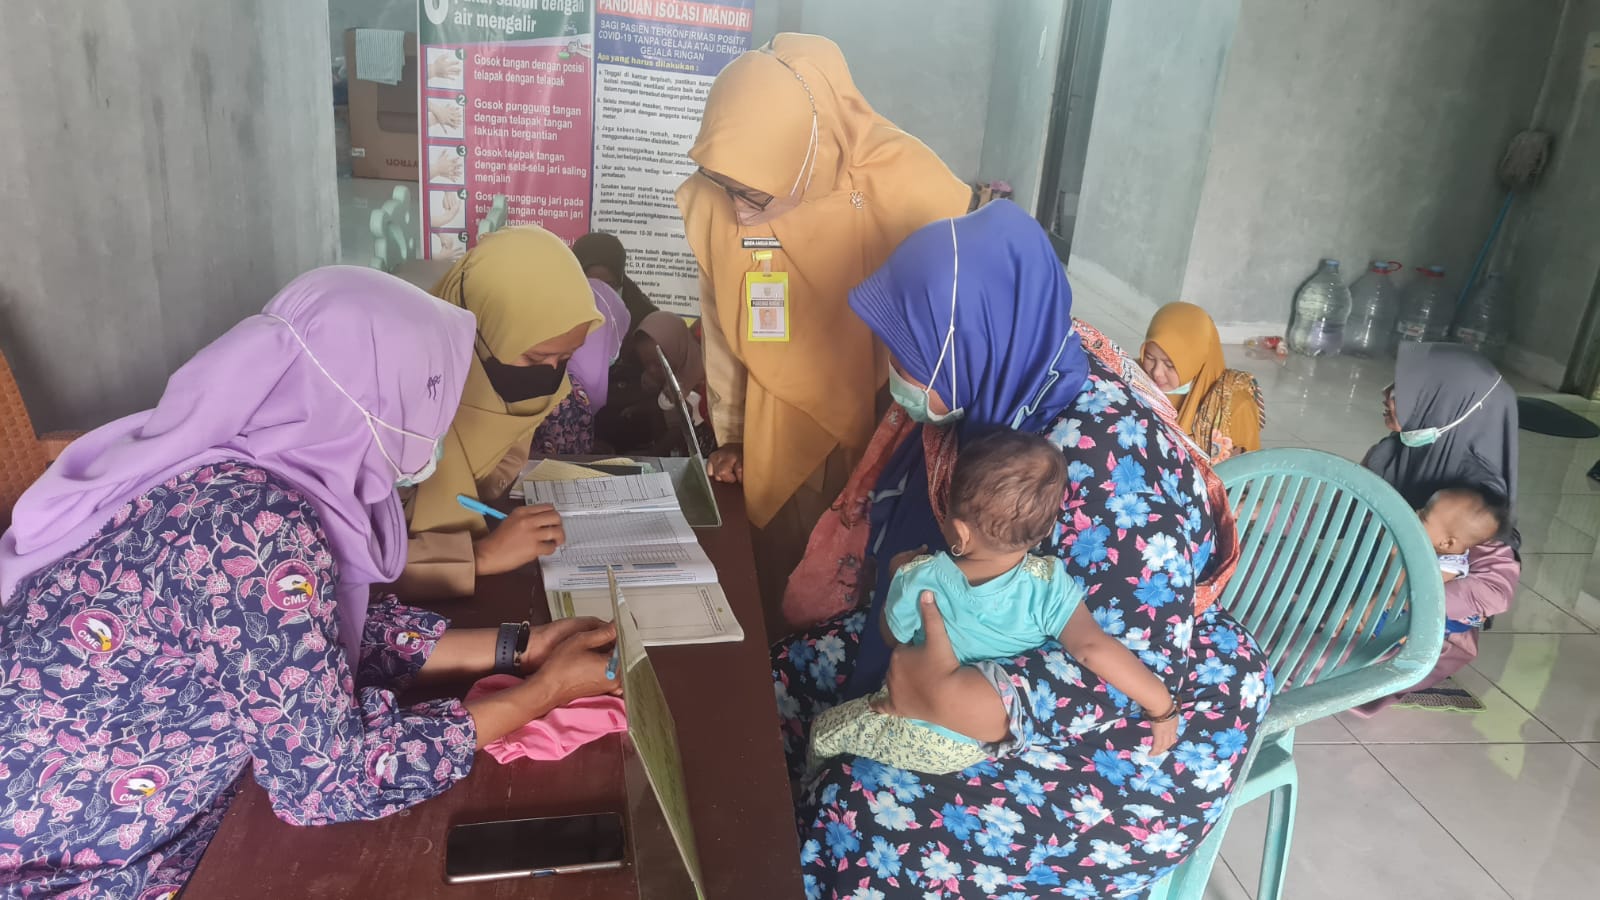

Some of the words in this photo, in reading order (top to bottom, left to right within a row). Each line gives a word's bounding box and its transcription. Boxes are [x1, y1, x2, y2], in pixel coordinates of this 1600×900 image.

[454, 9, 473, 26] air
[476, 13, 536, 34] mengalir
[600, 0, 651, 16] PANDUAN
[655, 1, 699, 22] ISOLASI
[703, 7, 750, 27] MANDIRI
[600, 20, 619, 30] BAGI
[620, 22, 650, 34] PASIEN
[651, 26, 717, 42] TERKONFIRMASI
[718, 34, 746, 45] POSITIF
[598, 31, 632, 42] COVID-19
[633, 34, 660, 47] TANPA
[662, 38, 693, 50] GELAJA
[694, 41, 715, 53] ATAU
[716, 44, 747, 55] DENGAN
[640, 46, 672, 58] GEJALA
[674, 49, 704, 61] RINGAN
[474, 54, 501, 67] Gosok
[503, 56, 529, 71] tangan
[531, 58, 562, 73] dengan
[563, 62, 585, 74] posisi
[610, 55, 630, 65] yang
[631, 57, 653, 67] harus
[655, 59, 695, 71] dilakukan
[474, 70, 503, 83] telapak
[505, 72, 535, 86] dengan
[536, 74, 564, 87] telapak
[458, 95, 465, 105] 2
[474, 98, 503, 110] Gosok
[505, 101, 550, 115] punggung
[552, 103, 582, 117] tangan
[474, 112, 508, 125] dengan
[510, 114, 540, 128] telapak
[544, 116, 573, 130] tangan
[474, 127, 509, 138] lakukan
[511, 128, 558, 141] bergantian
[459, 146, 466, 156] 3
[474, 147, 502, 158] Gosok
[504, 148, 535, 160] telapak
[537, 150, 565, 163] tangan
[475, 160, 506, 174] dengan
[508, 162, 545, 173] sela-sela
[547, 164, 560, 175] jari
[562, 166, 587, 178] saling
[475, 173, 511, 184] menjalin
[459, 189, 467, 199] 4
[475, 191, 494, 201] Gos
[549, 196, 562, 206] jari
[564, 197, 584, 207] pada
[508, 207, 536, 218] tangan
[538, 208, 568, 219] dengan
[570, 210, 583, 220] jari
[461, 232, 469, 242] 5
[283, 594, 307, 606] CME
[78, 630, 100, 649] CME
